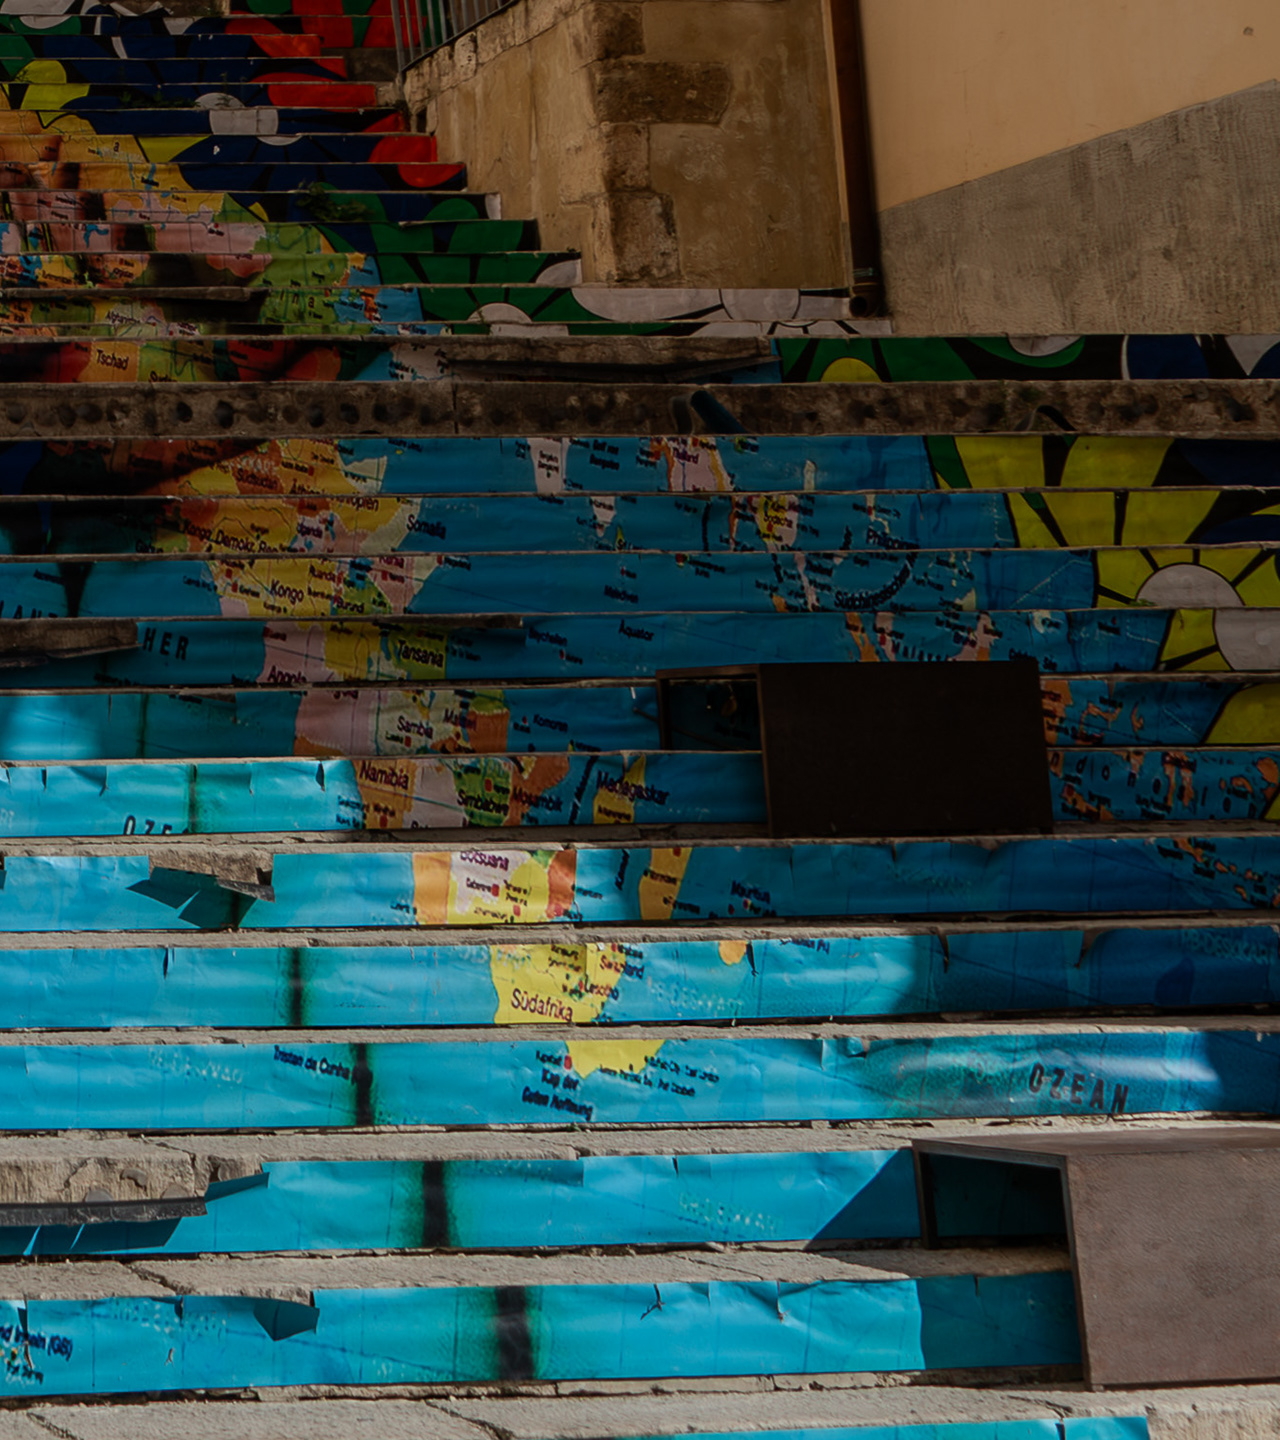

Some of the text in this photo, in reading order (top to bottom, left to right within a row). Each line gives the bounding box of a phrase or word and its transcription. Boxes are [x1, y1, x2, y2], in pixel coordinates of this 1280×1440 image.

[96, 349, 130, 370] Tschad
[270, 579, 305, 605] Kongo
[619, 619, 655, 642] Äquator
[397, 715, 434, 740] Sambia
[359, 760, 410, 791] Namibia
[511, 988, 574, 1022] Südafrika
[1028, 1062, 1129, 1114] OZEAN
